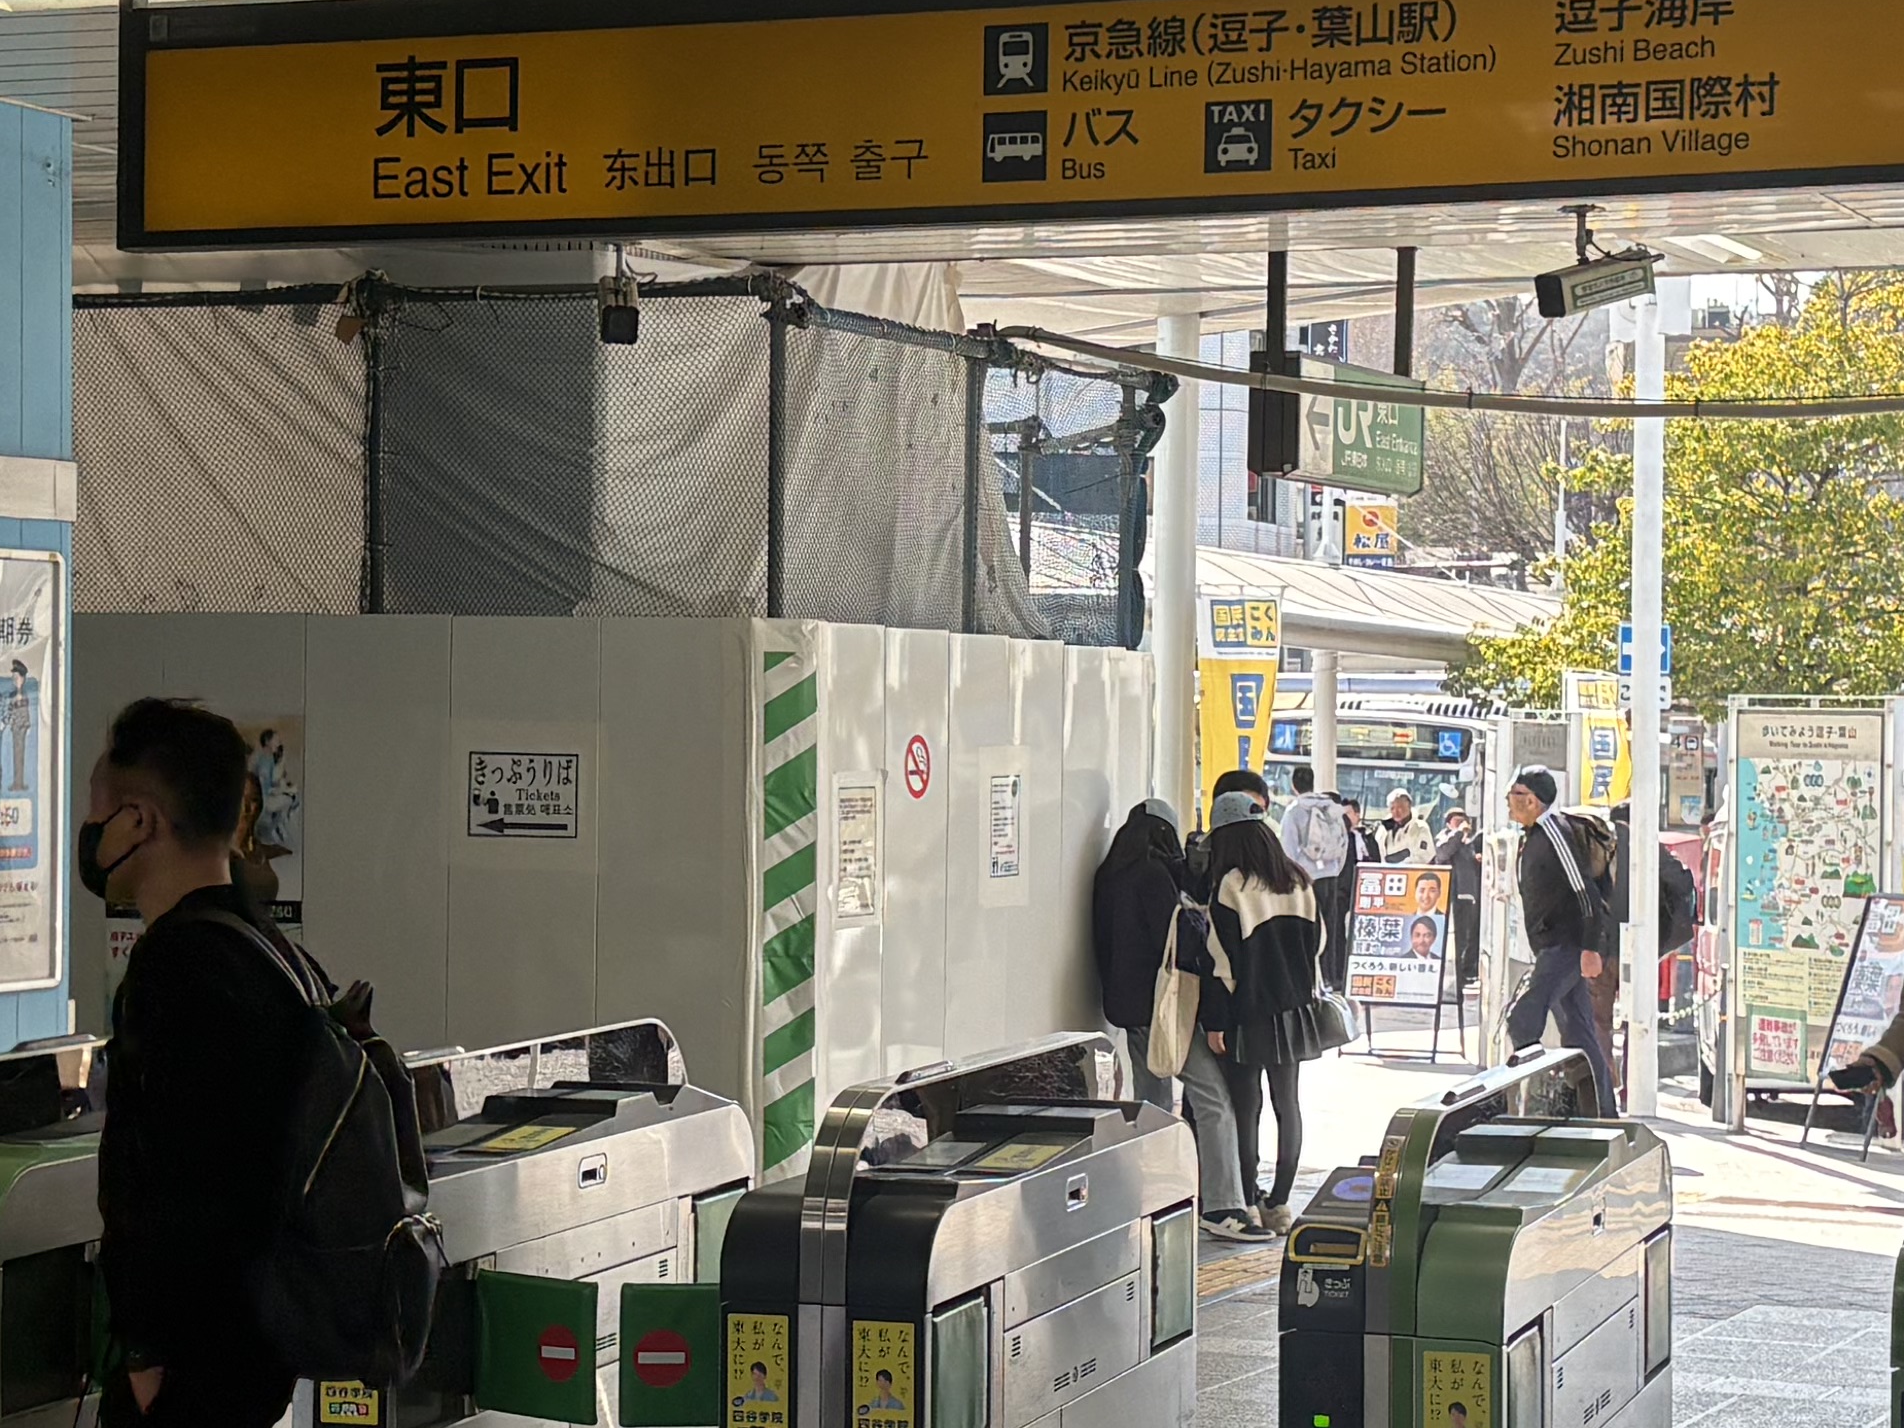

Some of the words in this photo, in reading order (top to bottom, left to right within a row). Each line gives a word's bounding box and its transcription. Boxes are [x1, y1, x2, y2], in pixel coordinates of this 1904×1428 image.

[1061, 67, 1140, 96] Keikyū
[1148, 62, 1198, 89] Line
[1399, 44, 1497, 78] Station)
[1553, 40, 1625, 67] Zushi
[1631, 35, 1717, 63] Beach
[374, 55, 521, 140] 東口
[1208, 102, 1268, 124] TAXI
[1287, 96, 1447, 141] タクシー
[1552, 72, 1780, 128] 湘南国際村
[1062, 106, 1141, 149] バス
[1550, 133, 1655, 160] Shonan
[1661, 127, 1751, 158] Village
[371, 156, 470, 201] East
[485, 151, 570, 198] Exit
[601, 146, 718, 193] 东出口
[751, 141, 830, 187] 동쪽
[850, 137, 930, 182] 출구
[1060, 157, 1107, 183] Bus
[1286, 147, 1337, 172] Taxi
[474, 756, 573, 787] きっぷうりば
[515, 788, 561, 802] Tickets
